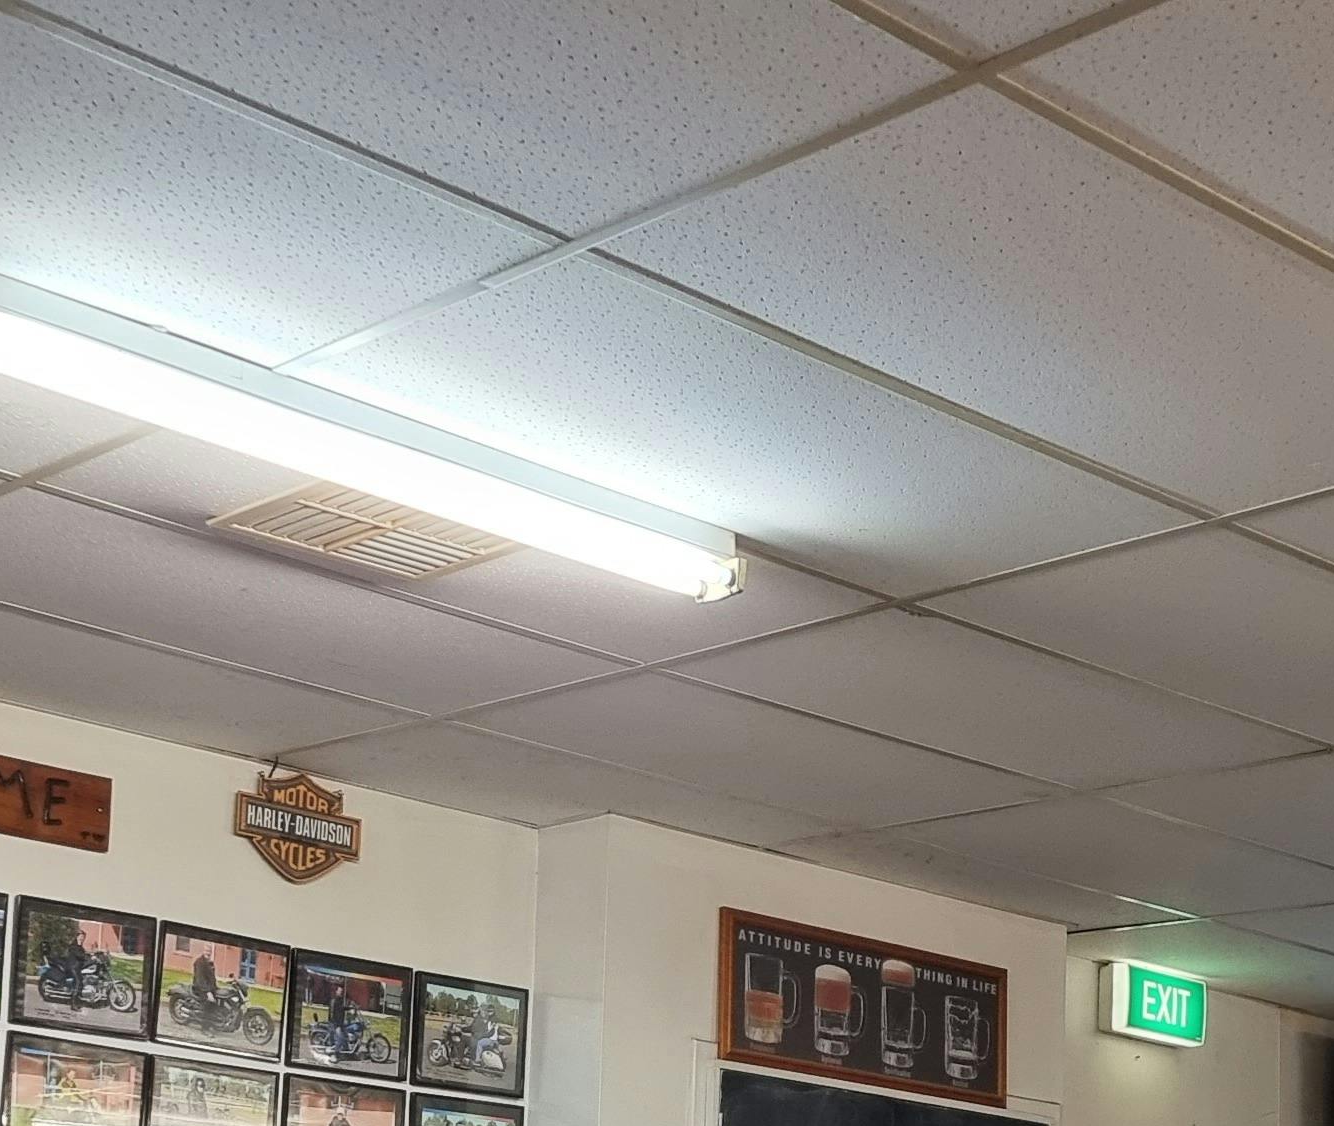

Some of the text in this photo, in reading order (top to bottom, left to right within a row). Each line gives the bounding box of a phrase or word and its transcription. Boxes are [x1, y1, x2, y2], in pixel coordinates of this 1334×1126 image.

[273, 784, 329, 814] MOTOR
[247, 803, 352, 847] HARLEY-DAVIDSON
[270, 838, 326, 871] CYCLES
[738, 928, 998, 996] ATTITUDE IS EVERY THING IN LIFE
[1142, 979, 1191, 1028] EXIT
